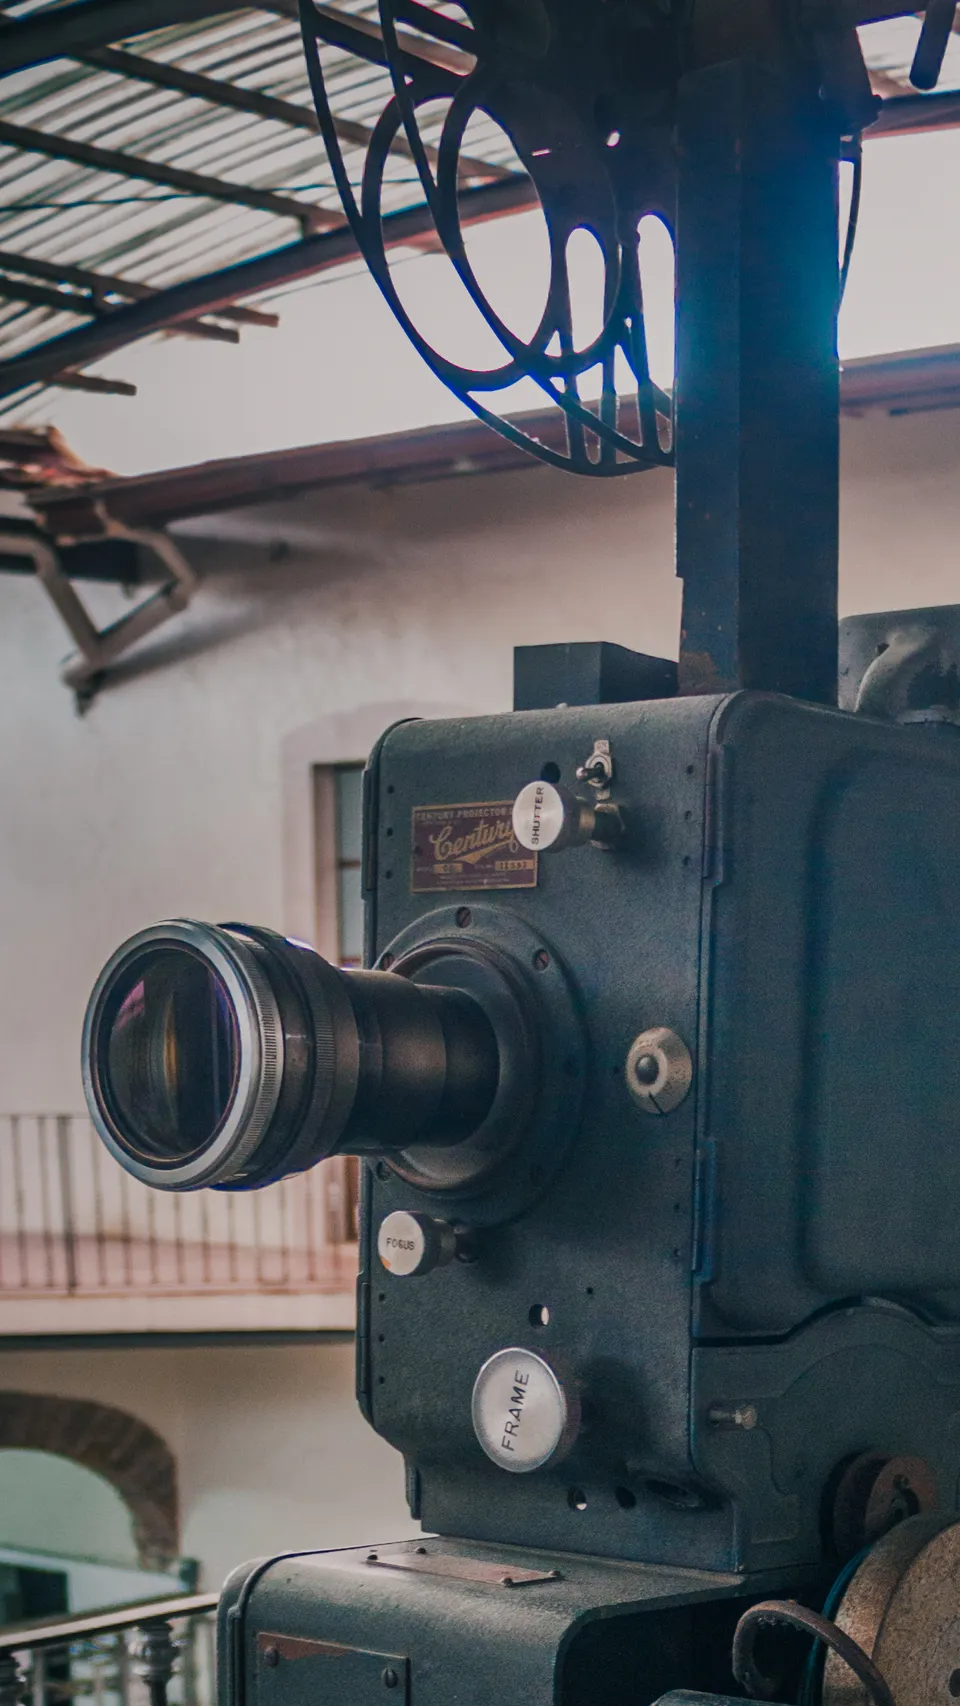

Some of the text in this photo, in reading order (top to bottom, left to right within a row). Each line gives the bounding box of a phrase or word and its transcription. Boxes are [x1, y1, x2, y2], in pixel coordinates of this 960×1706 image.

[456, 807, 508, 819] PROJECTOR
[531, 787, 545, 845] SHUTTER
[428, 820, 519, 860] Century
[386, 1237, 415, 1251] FOCUS
[501, 1369, 530, 1452] FRAME
